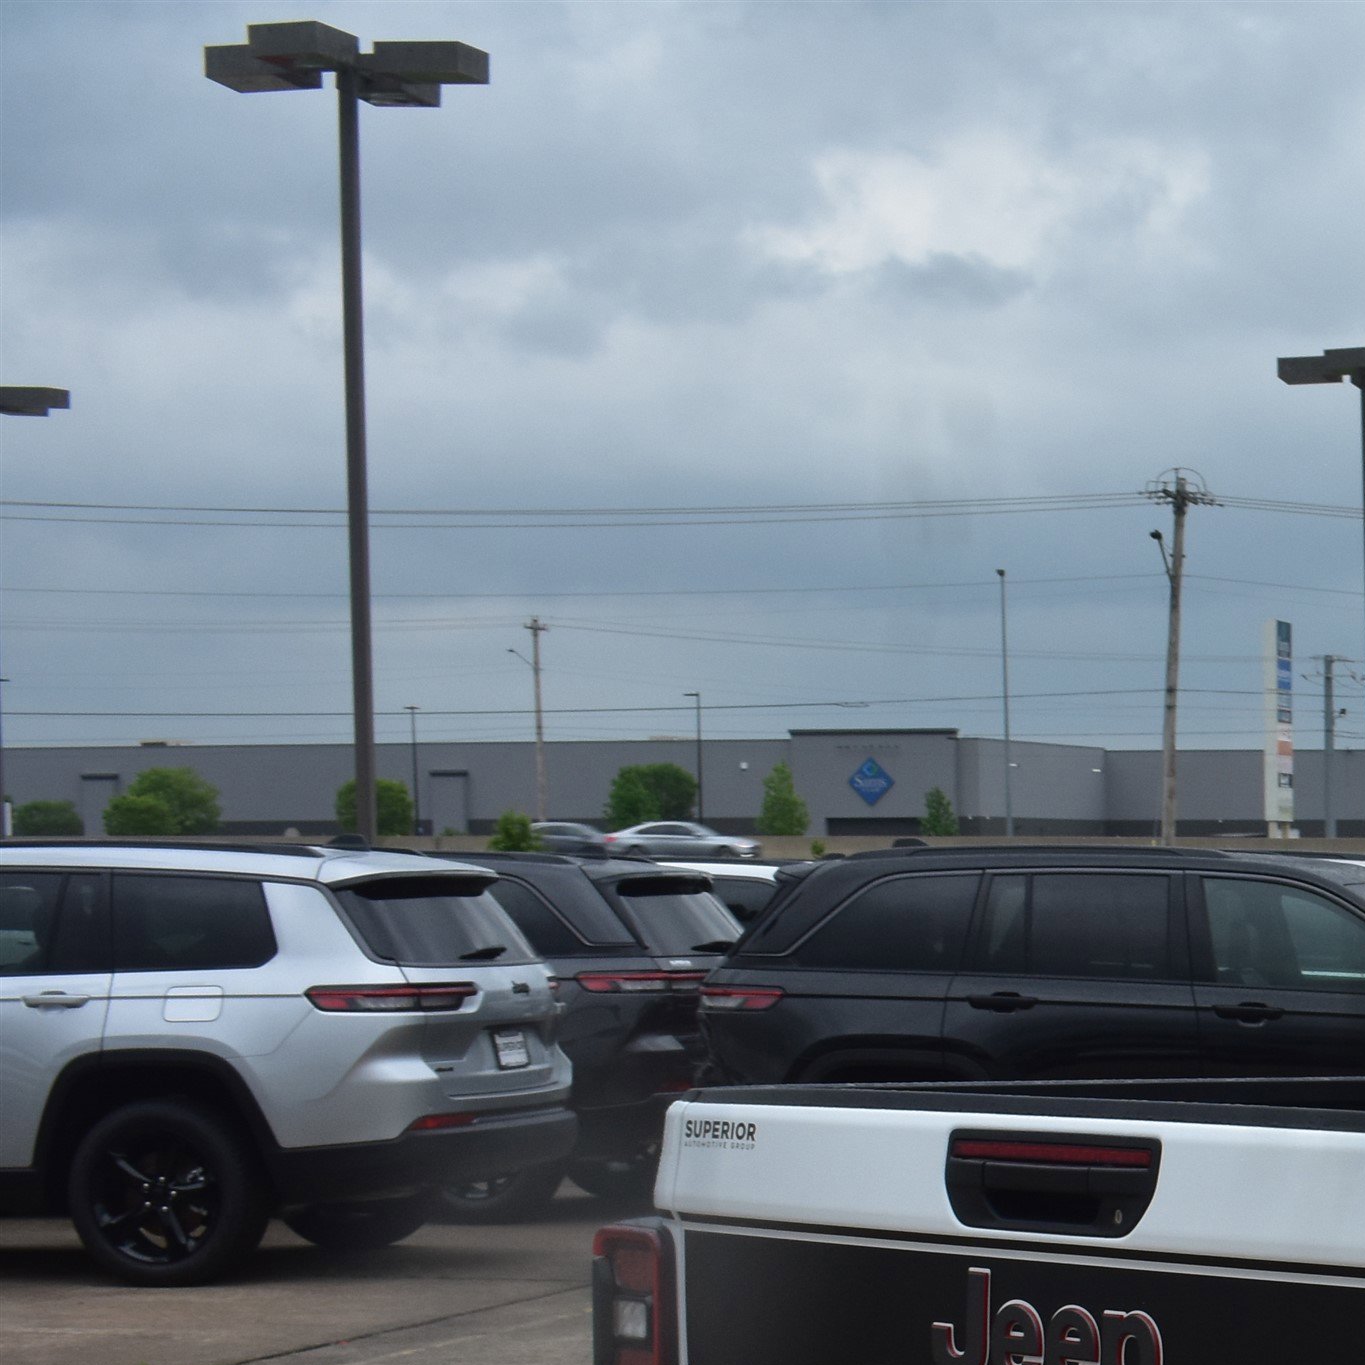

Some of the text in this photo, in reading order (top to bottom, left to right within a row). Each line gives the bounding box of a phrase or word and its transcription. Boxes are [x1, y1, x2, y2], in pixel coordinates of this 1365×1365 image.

[685, 1120, 757, 1141] SUPERIOR
[684, 1140, 756, 1151] AUTOMOTIVE GROUP
